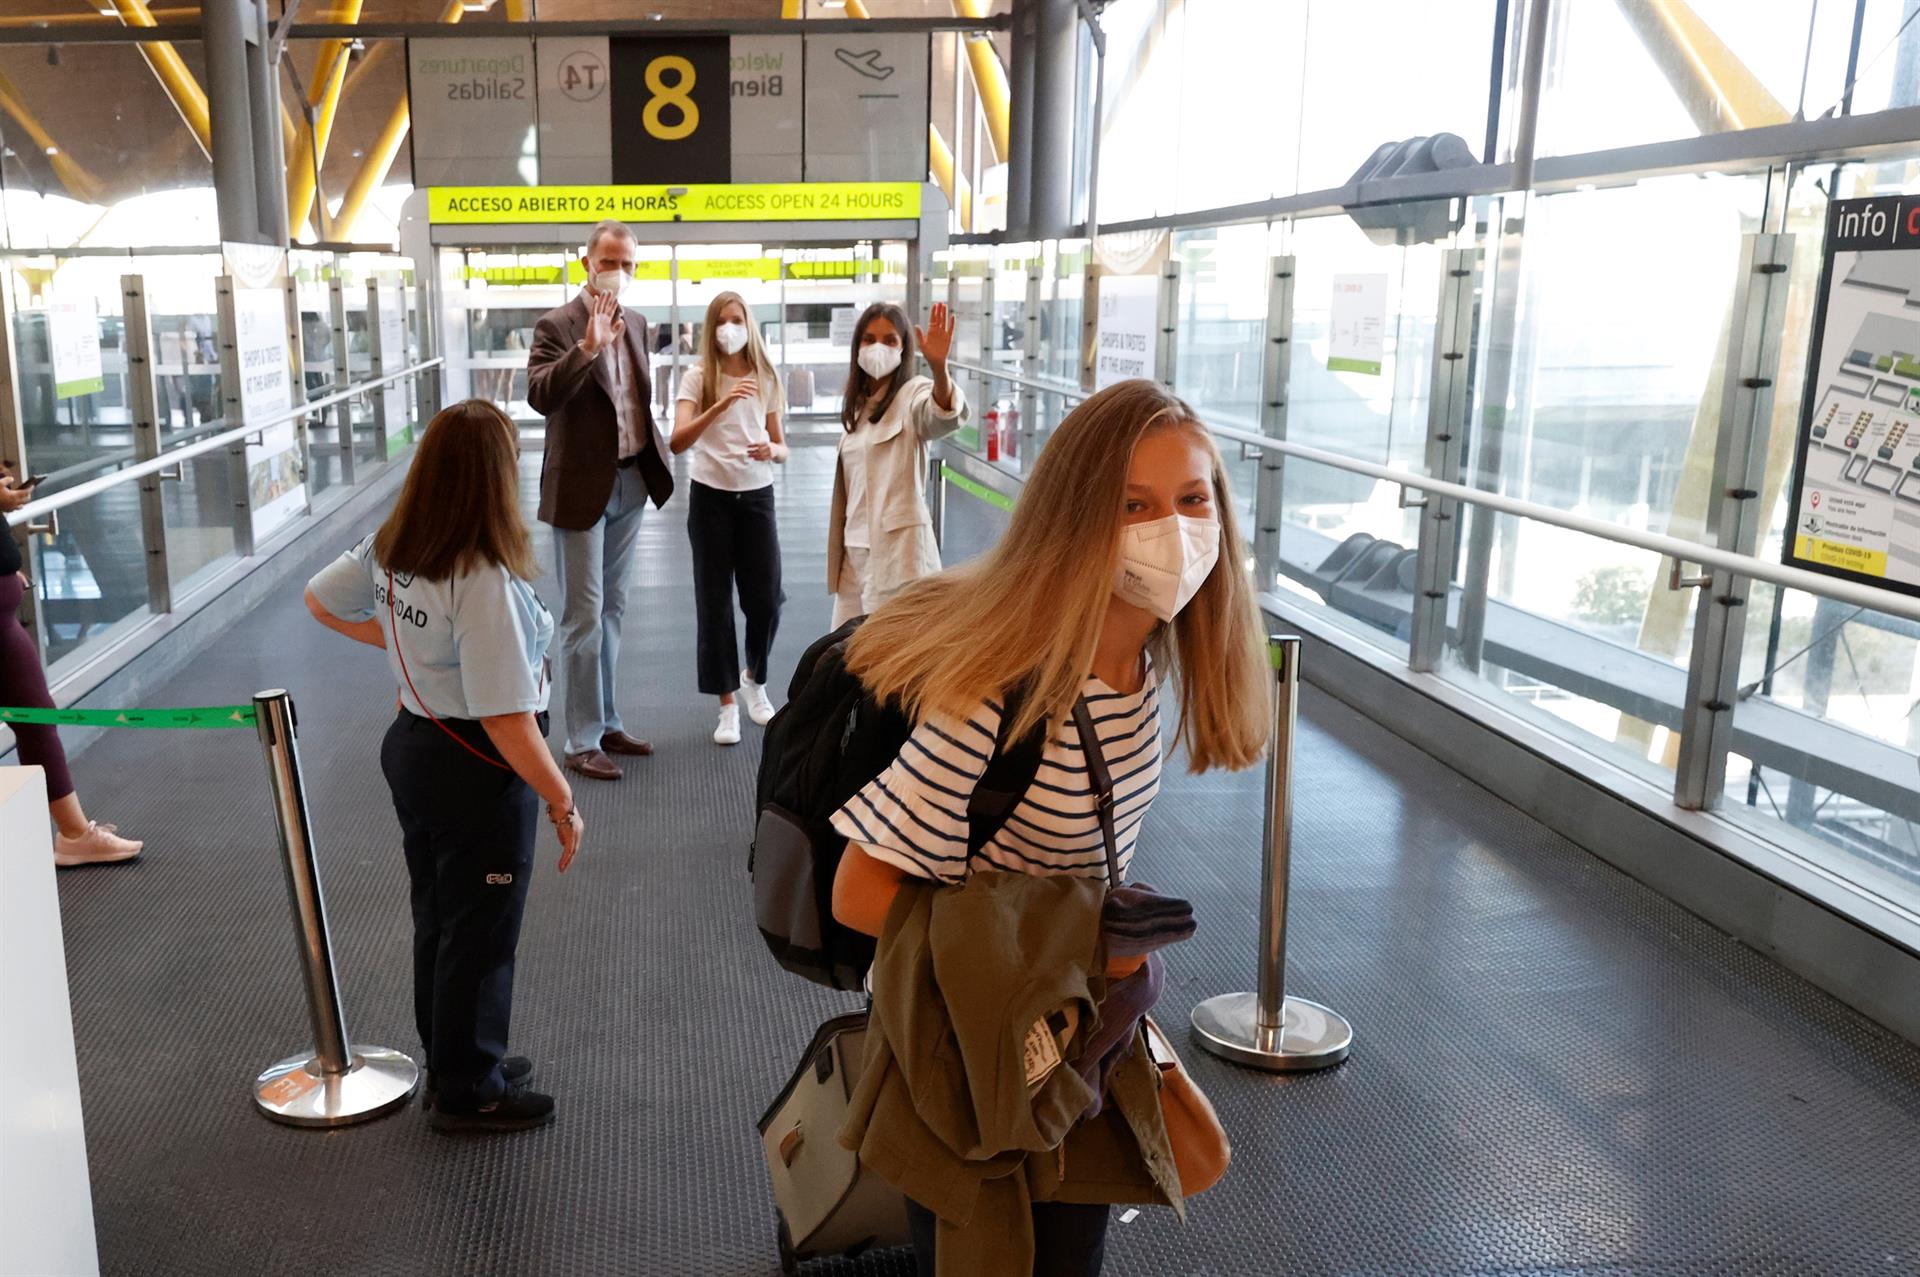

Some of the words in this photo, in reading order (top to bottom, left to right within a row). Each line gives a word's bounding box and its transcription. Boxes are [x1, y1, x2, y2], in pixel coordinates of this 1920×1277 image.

[642, 56, 700, 140] 8
[448, 198, 512, 212] ACCESO
[518, 196, 590, 212] ABIERTO
[596, 196, 615, 211] 24
[622, 196, 678, 211] HORAS
[704, 194, 765, 210] ACCESS
[771, 194, 814, 209] OPEN
[820, 194, 840, 208] 24
[846, 193, 904, 208] HOURS
[1837, 202, 1886, 238] info
